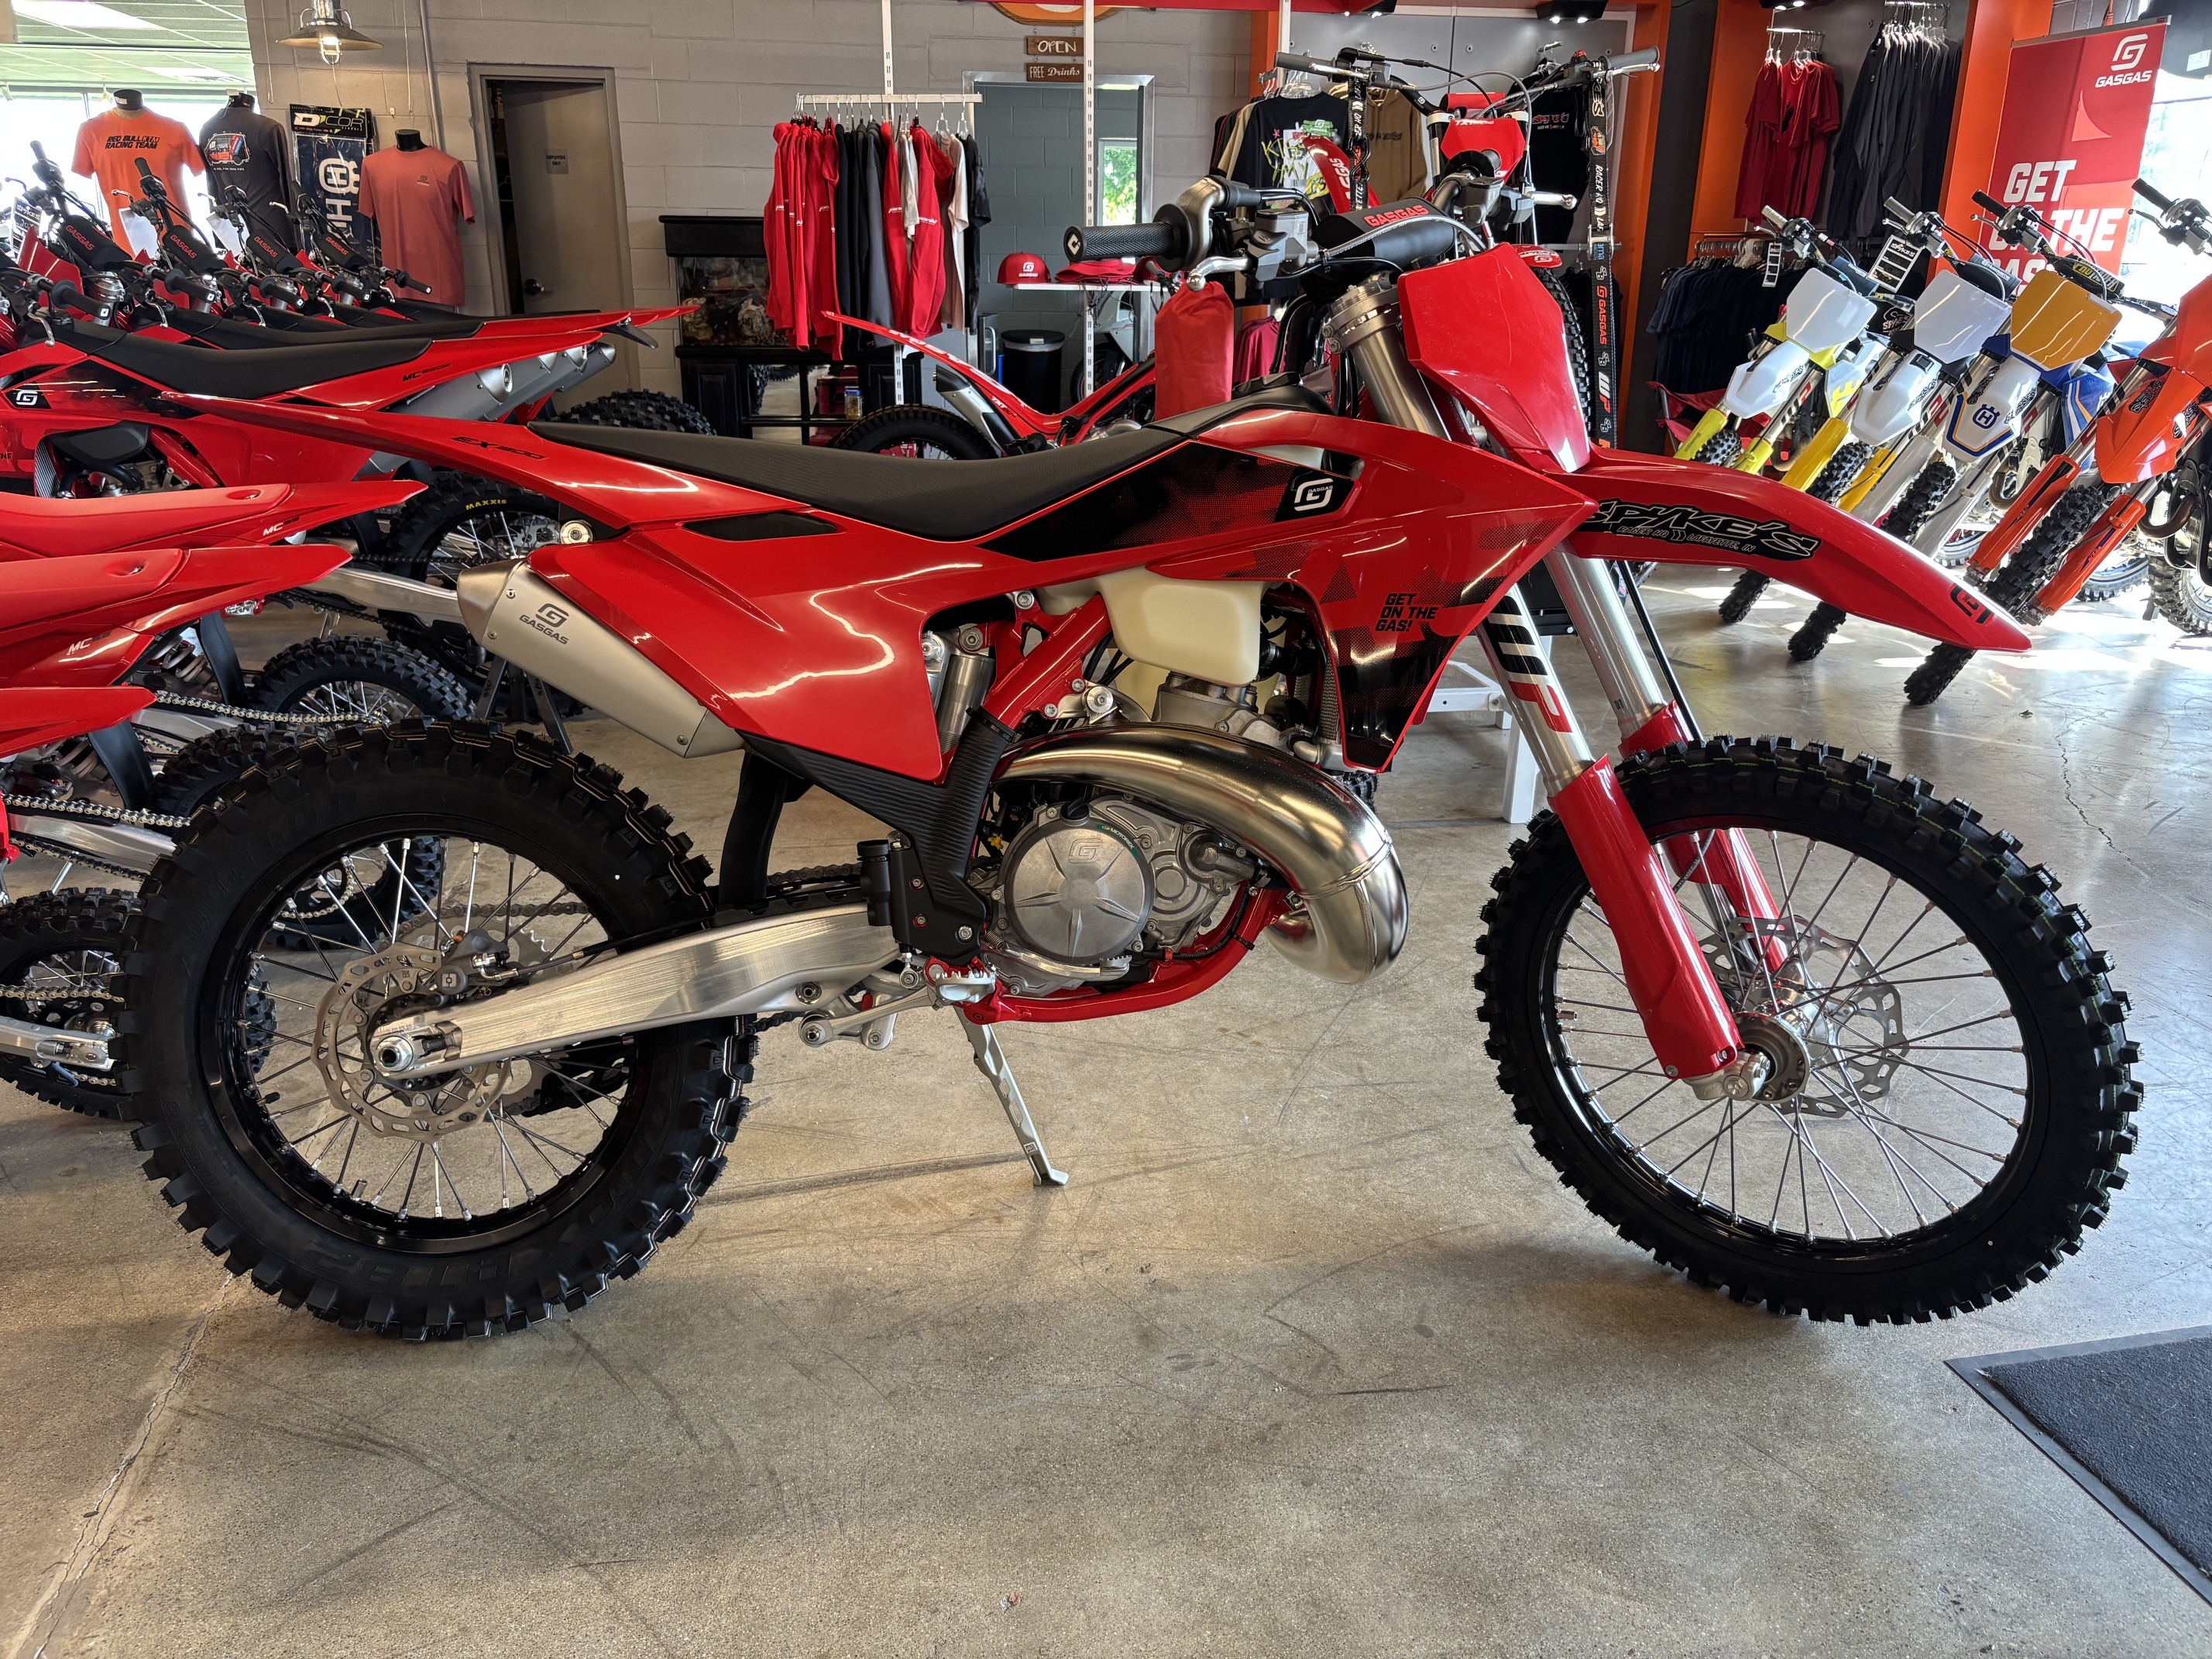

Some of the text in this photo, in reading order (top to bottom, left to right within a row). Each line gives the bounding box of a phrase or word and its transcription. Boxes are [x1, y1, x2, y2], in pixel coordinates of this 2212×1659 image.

[1038, 40, 1077, 53] OPEN
[1029, 66, 1080, 78] FREE Drinks
[2095, 70, 2152, 88] GASGAS
[1595, 164, 1603, 192] RACER
[2003, 160, 2077, 203] GET
[1364, 204, 1429, 227] GASGAS
[65, 225, 95, 251] GASGAS
[2045, 208, 2125, 252] THE
[170, 234, 197, 259] GASGAS
[253, 236, 278, 258] GASGAS
[325, 236, 349, 256] GASGAS
[1599, 300, 1607, 345] GASGAS
[465, 500, 507, 510] MAXXIS
[263, 522, 283, 536] MC
[1616, 526, 1756, 552] RACER HQ LAFAYETTE, IN
[1385, 592, 1417, 606] GET
[1380, 606, 1439, 620] ON THE
[519, 614, 569, 645] GASGAS
[1375, 619, 1413, 632] GAS!
[67, 637, 92, 656] MC
[1110, 827, 1135, 850] MOTOREX
